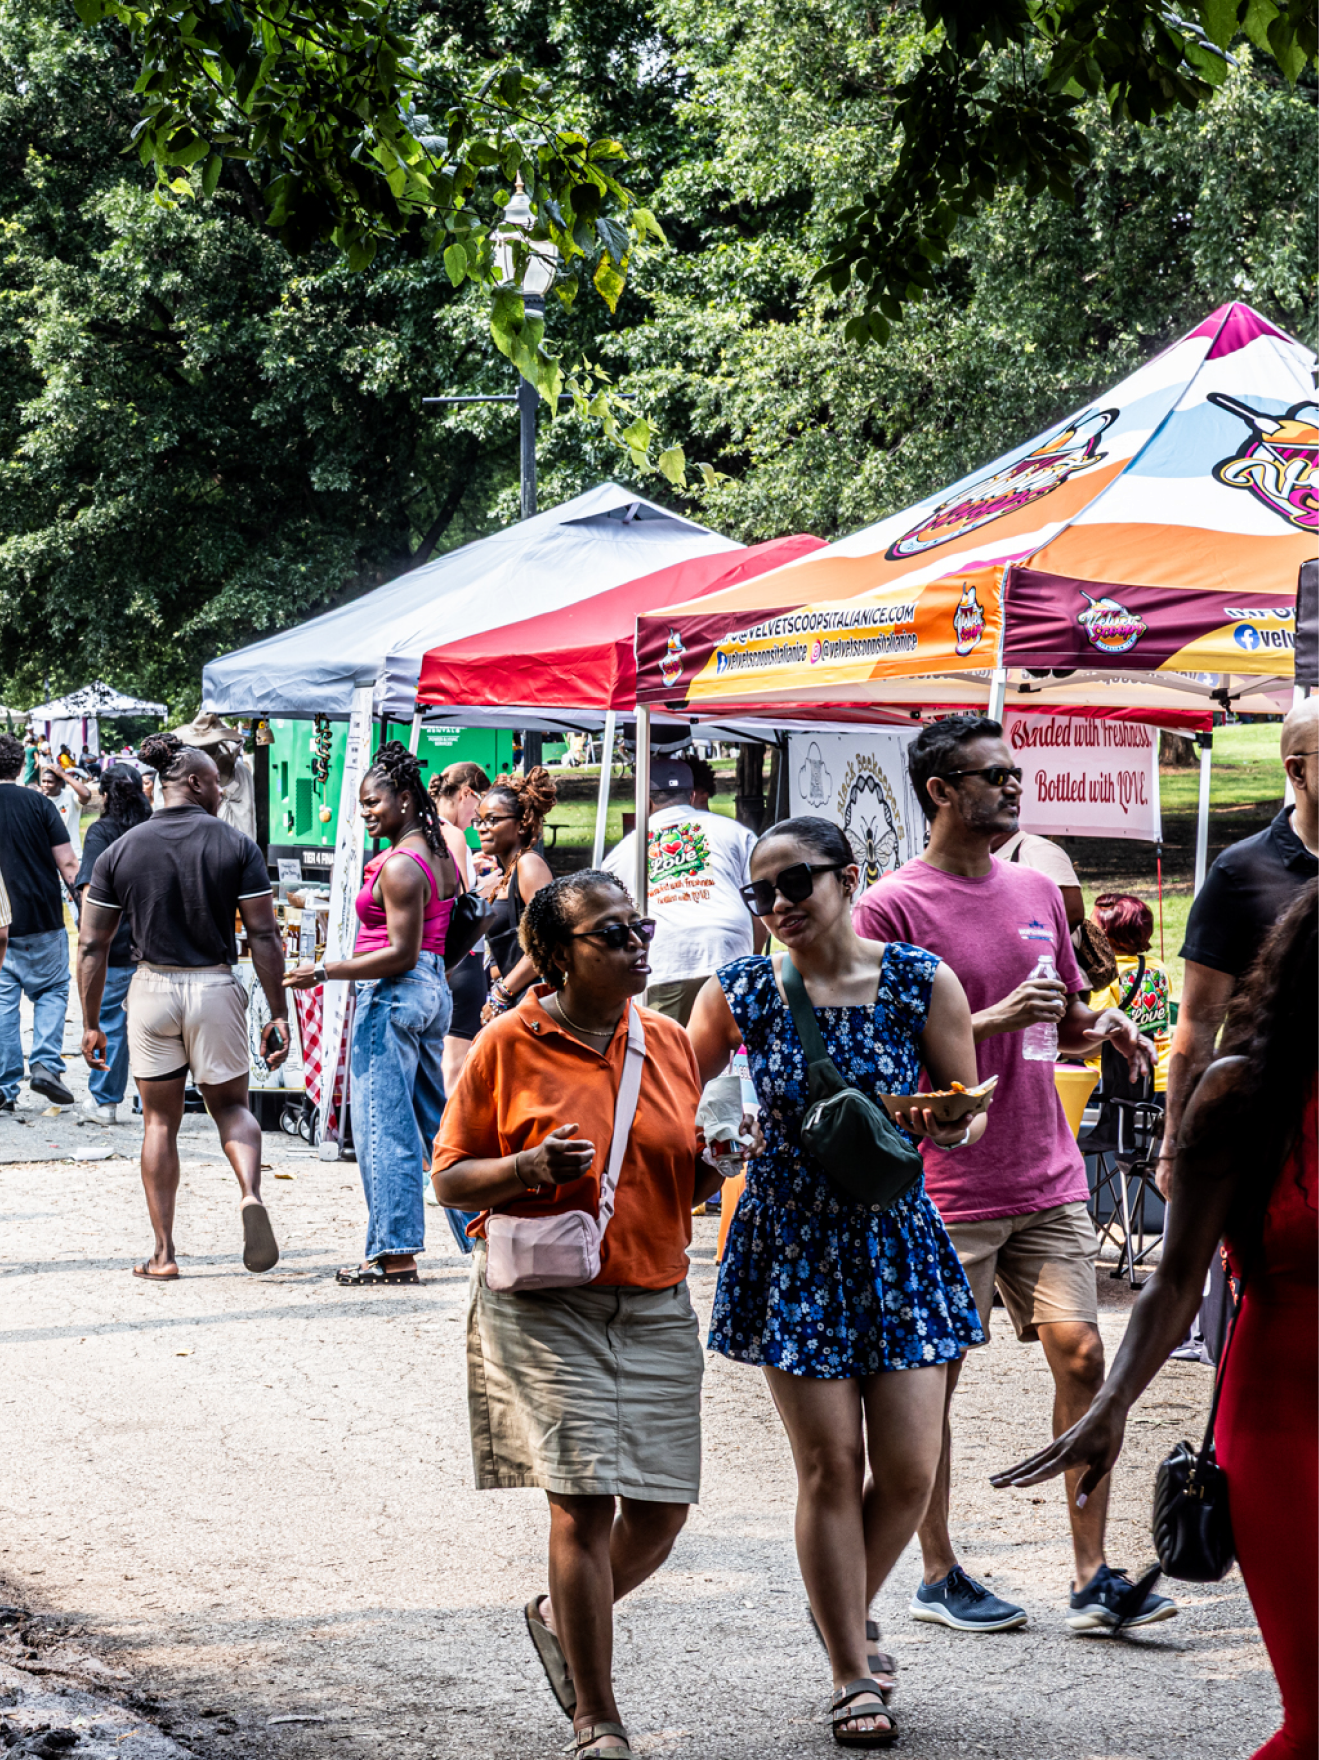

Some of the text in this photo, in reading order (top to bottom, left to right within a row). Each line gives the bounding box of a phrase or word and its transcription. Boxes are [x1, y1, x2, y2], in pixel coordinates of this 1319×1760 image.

[1010, 717, 1072, 750] Blended
[1074, 718, 1101, 747] with
[1034, 769, 1086, 803] Bottled
[1089, 771, 1115, 804] with
[649, 850, 698, 880] Love
[1131, 1008, 1166, 1027] Love
